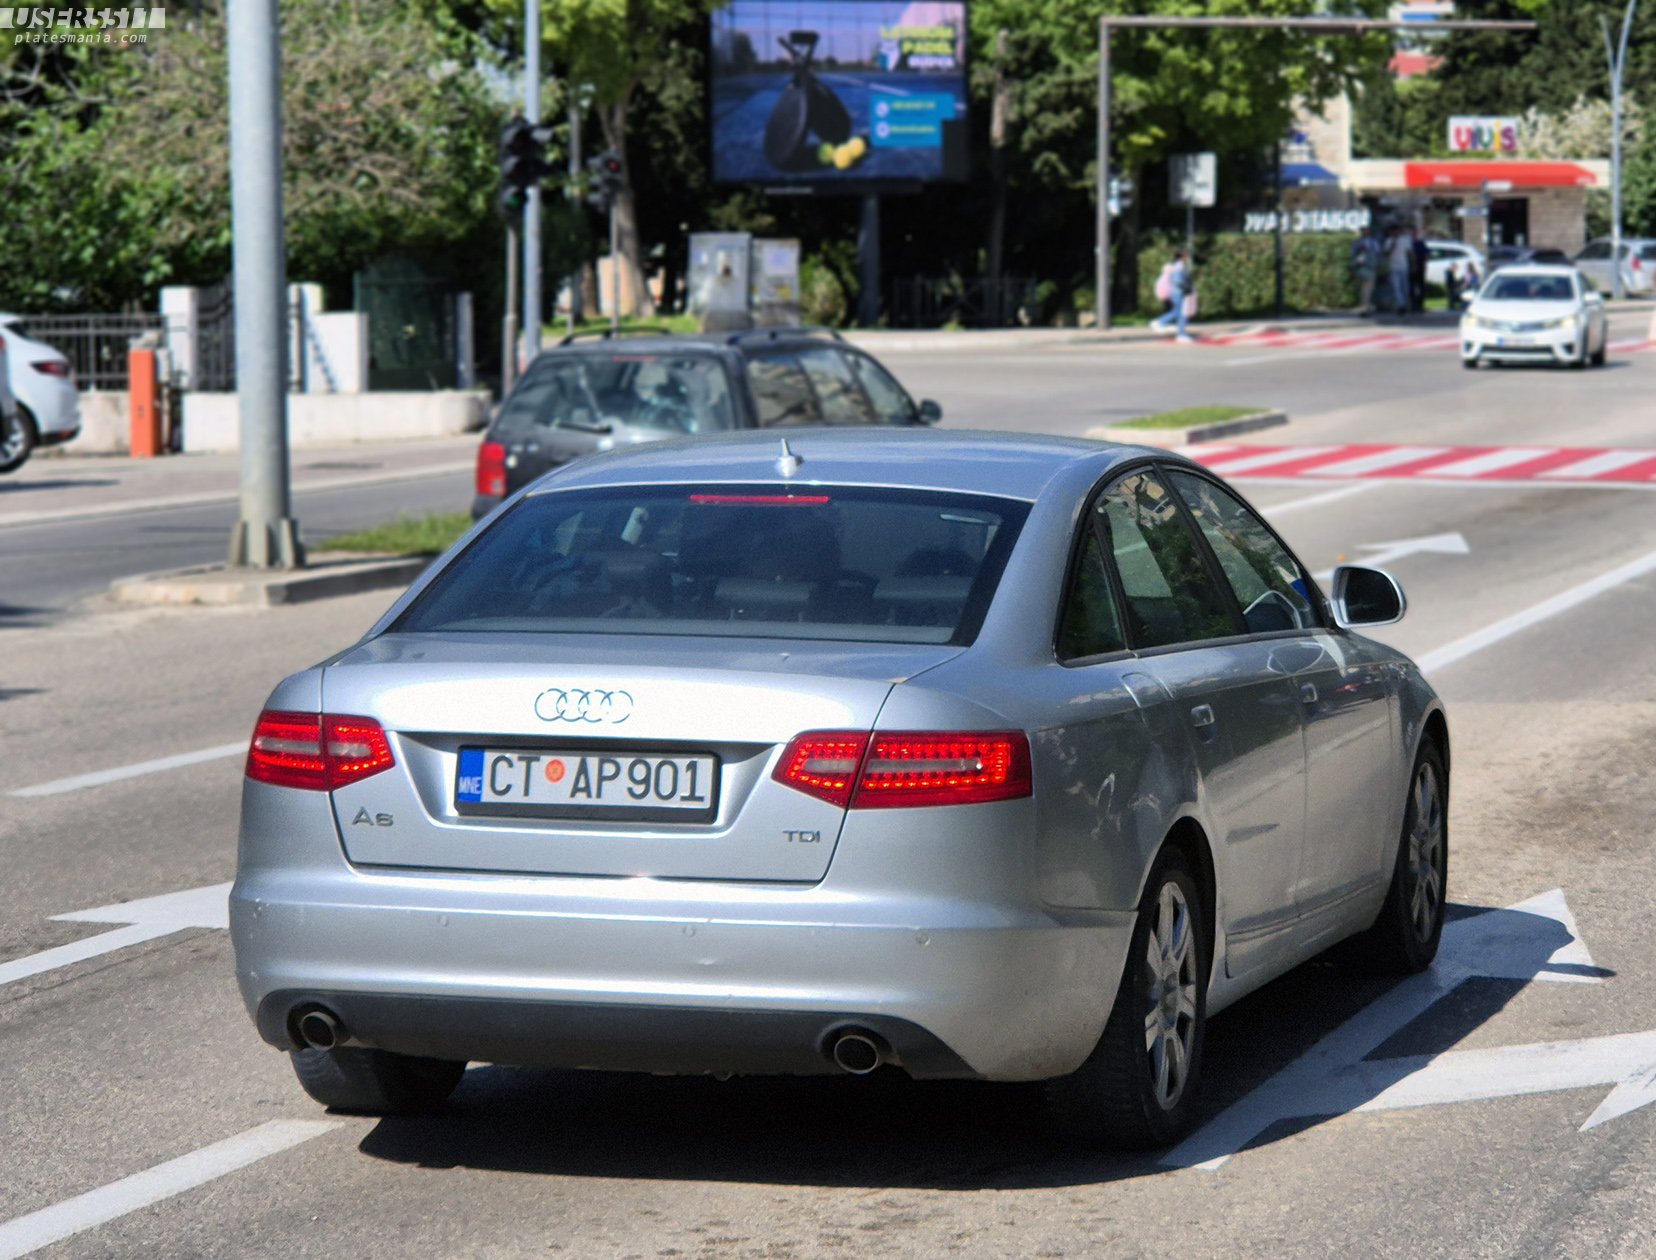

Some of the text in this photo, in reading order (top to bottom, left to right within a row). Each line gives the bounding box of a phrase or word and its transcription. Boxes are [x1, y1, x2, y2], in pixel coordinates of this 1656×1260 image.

[458, 776, 482, 794] MNE
[490, 755, 705, 802] CT AP901
[352, 806, 394, 826] A6
[782, 829, 820, 843] TDI
